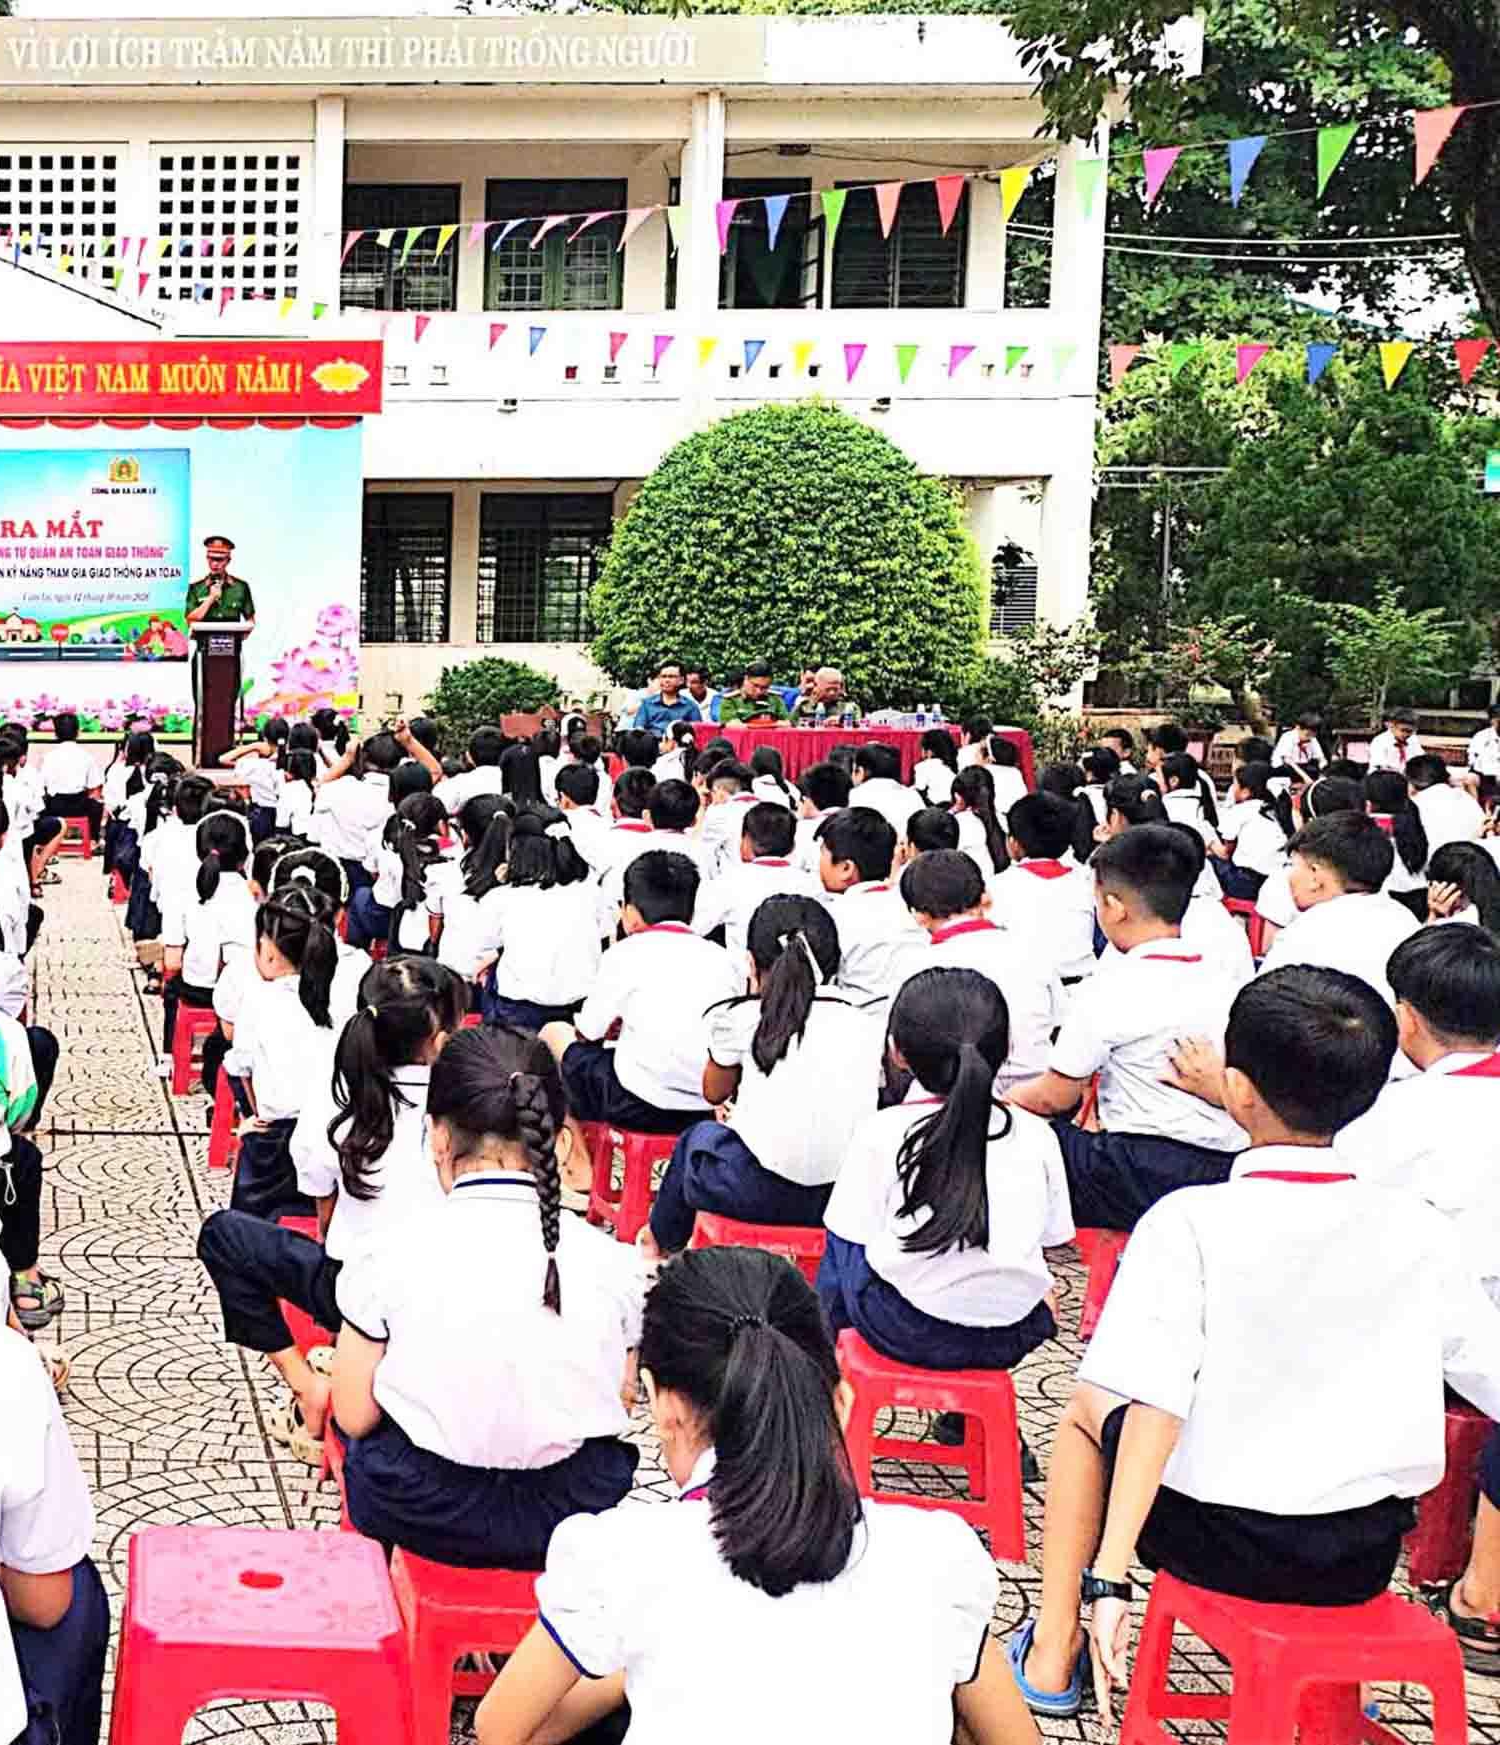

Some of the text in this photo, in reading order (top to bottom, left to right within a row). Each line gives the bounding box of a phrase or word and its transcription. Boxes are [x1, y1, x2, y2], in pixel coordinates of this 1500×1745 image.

[5, 26, 40, 69] VÌ
[50, 31, 100, 78] LỢI
[107, 28, 162, 69] ÍCH
[173, 26, 255, 69] TRĂM
[266, 24, 332, 69] NĂM
[403, 22, 476, 68] PHẢI
[27, 354, 86, 400] VIỆT
[95, 363, 150, 394] NAM
[159, 354, 227, 394] MUÔN
[0, 519, 37, 538] RA
[46, 509, 103, 538] MẮT
[46, 567, 69, 577] THAM
[71, 567, 87, 578] GIA
[89, 567, 111, 578] GIAO
[145, 567, 157, 577] AN
